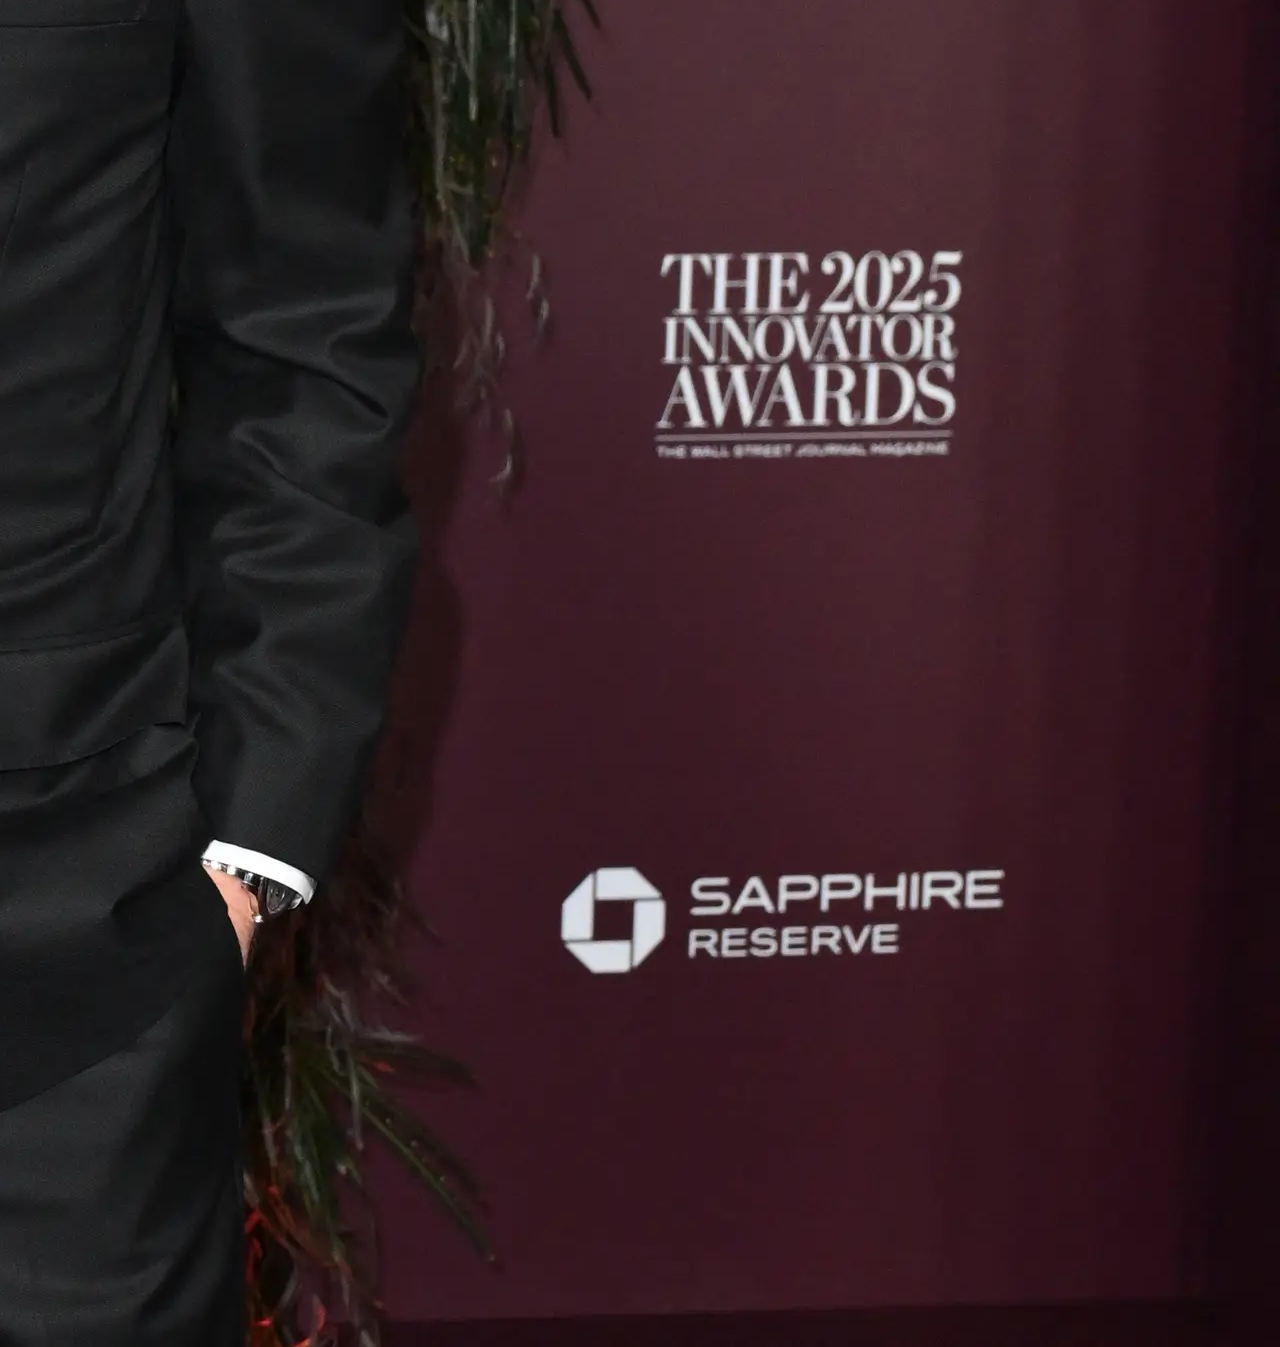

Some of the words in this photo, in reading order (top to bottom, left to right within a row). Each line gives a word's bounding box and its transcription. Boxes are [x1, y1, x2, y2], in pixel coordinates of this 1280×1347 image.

[660, 252, 810, 315] THE
[820, 250, 964, 313] 2025
[662, 314, 958, 364] INNOVATOR
[655, 362, 957, 429] AWARDS
[657, 445, 687, 459] THE
[734, 444, 794, 458] STREET
[689, 869, 1005, 916] SAPPHIRE
[688, 923, 900, 958] RESERVE
